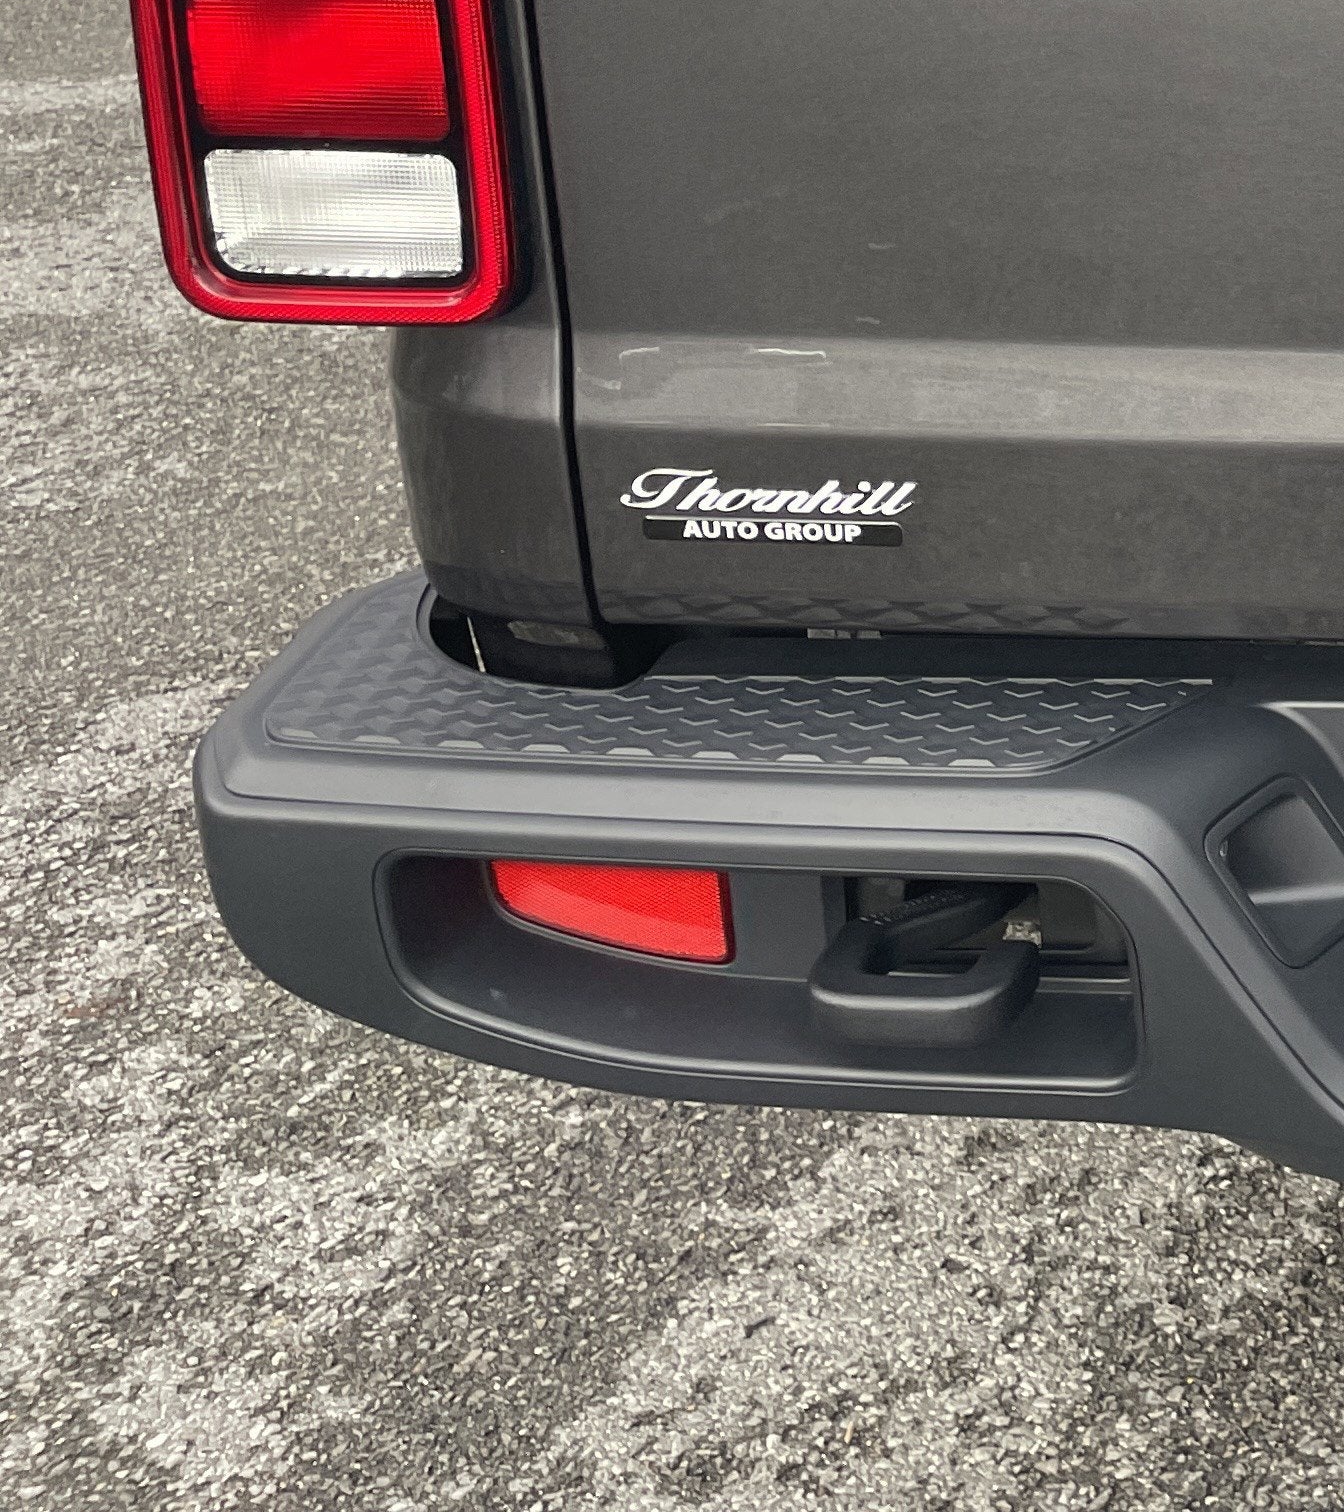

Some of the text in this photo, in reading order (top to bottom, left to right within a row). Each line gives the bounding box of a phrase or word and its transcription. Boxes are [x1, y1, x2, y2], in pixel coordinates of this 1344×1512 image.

[619, 467, 918, 517] Thornhill
[683, 519, 862, 543] AUTO GROUP
